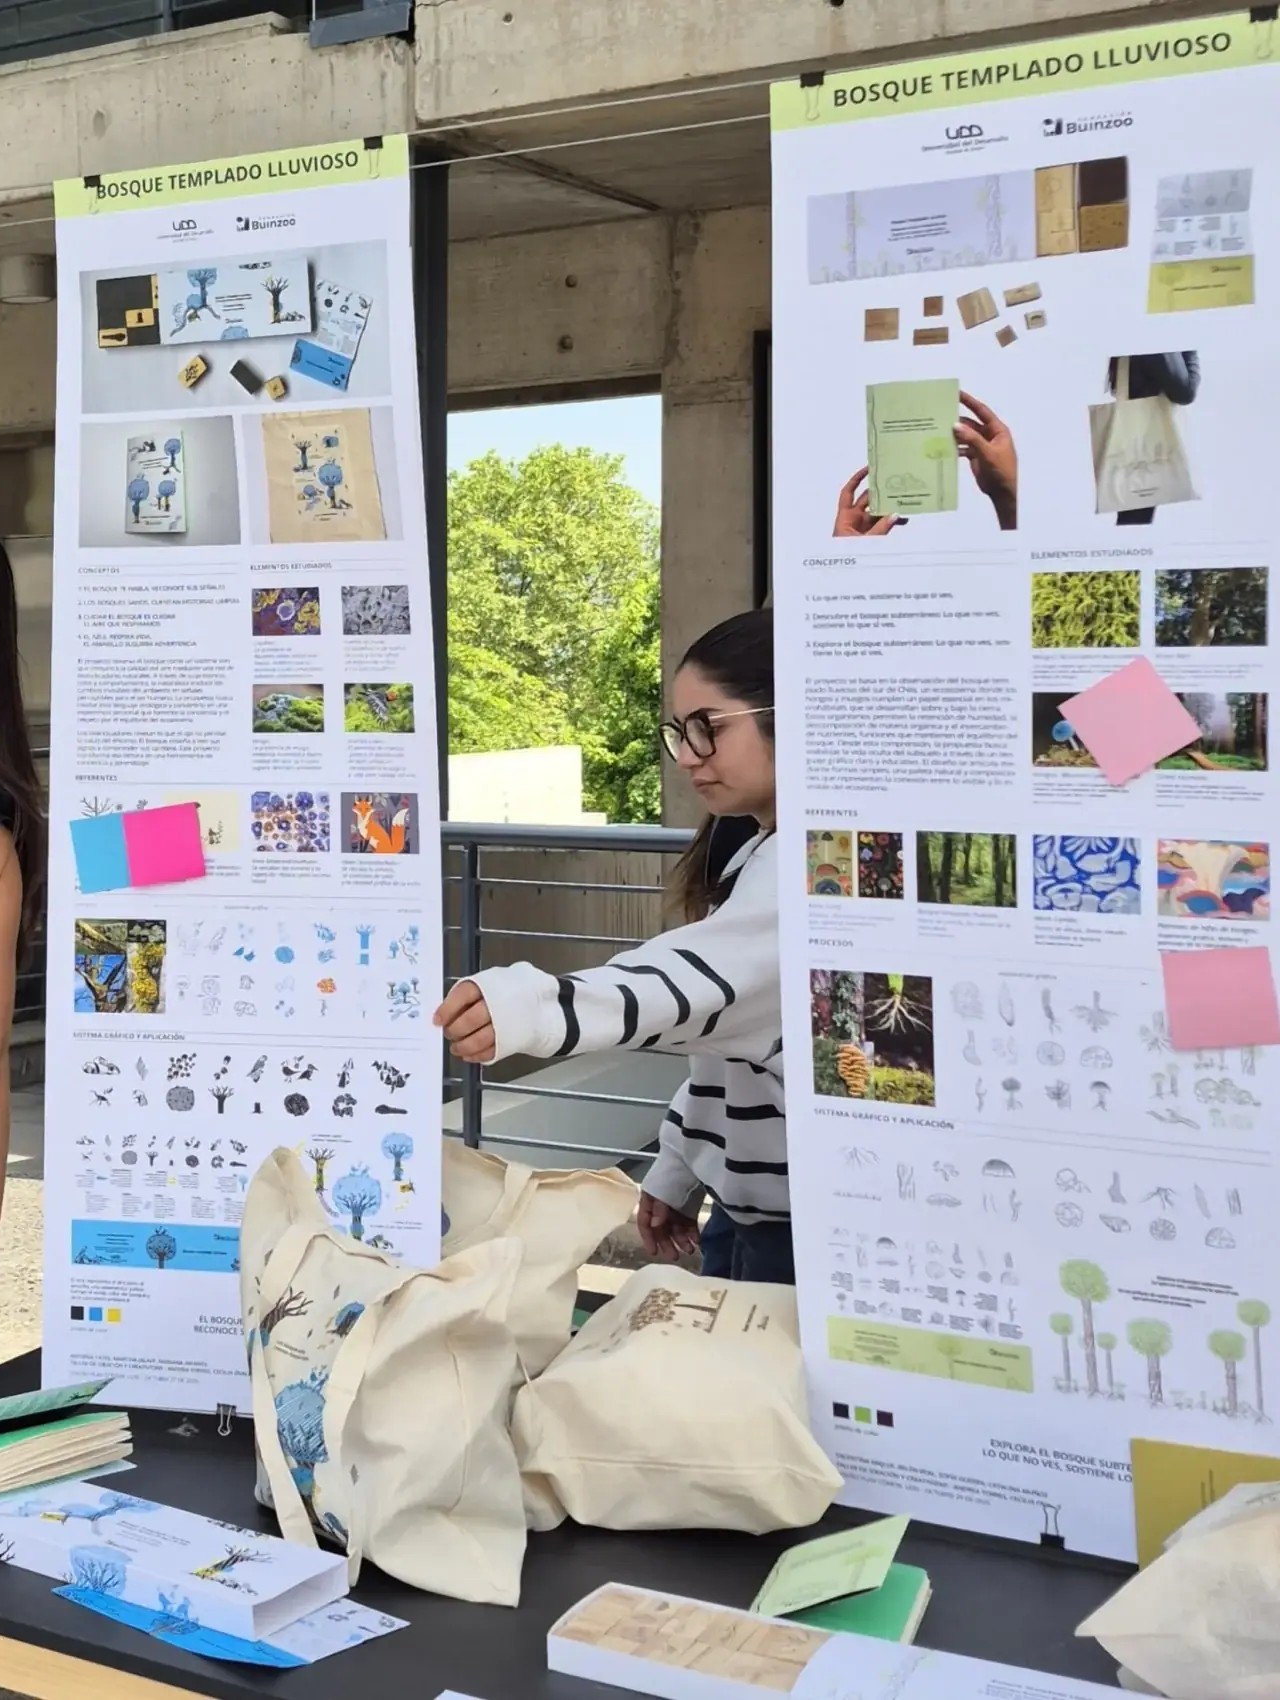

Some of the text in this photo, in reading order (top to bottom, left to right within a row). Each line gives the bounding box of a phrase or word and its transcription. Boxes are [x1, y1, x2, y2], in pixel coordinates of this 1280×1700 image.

[832, 32, 1232, 107] BOSQUE TEMPLADO LLUVIOSO
[1066, 116, 1134, 134] Buinzoo
[946, 124, 984, 140] UDD
[96, 151, 359, 200] BOSQUE TEMPLADO LLUVIOSO
[172, 220, 197, 231] UDD
[252, 218, 296, 230] Buinzoo
[1030, 550, 1088, 560] ELEMENTOS
[803, 558, 856, 566] CONCEPTOS
[806, 808, 858, 817] REFERENTES
[808, 938, 854, 948] PROCESOS
[142, 1032, 186, 1040] APLICACIÓN
[900, 1117, 955, 1130] APLICACIÓN
[199, 1315, 208, 1324] EL
[194, 1325, 238, 1335] RECONOCE
[990, 1438, 1132, 1472] EXPLORA EL BOSQUE SUBTE
[982, 1449, 996, 1458] LO
[998, 1451, 1020, 1463] QUE
[1022, 1456, 1040, 1467] NO
[1042, 1458, 1063, 1472] VES,
[1065, 1463, 1114, 1482] SOSTIENE
